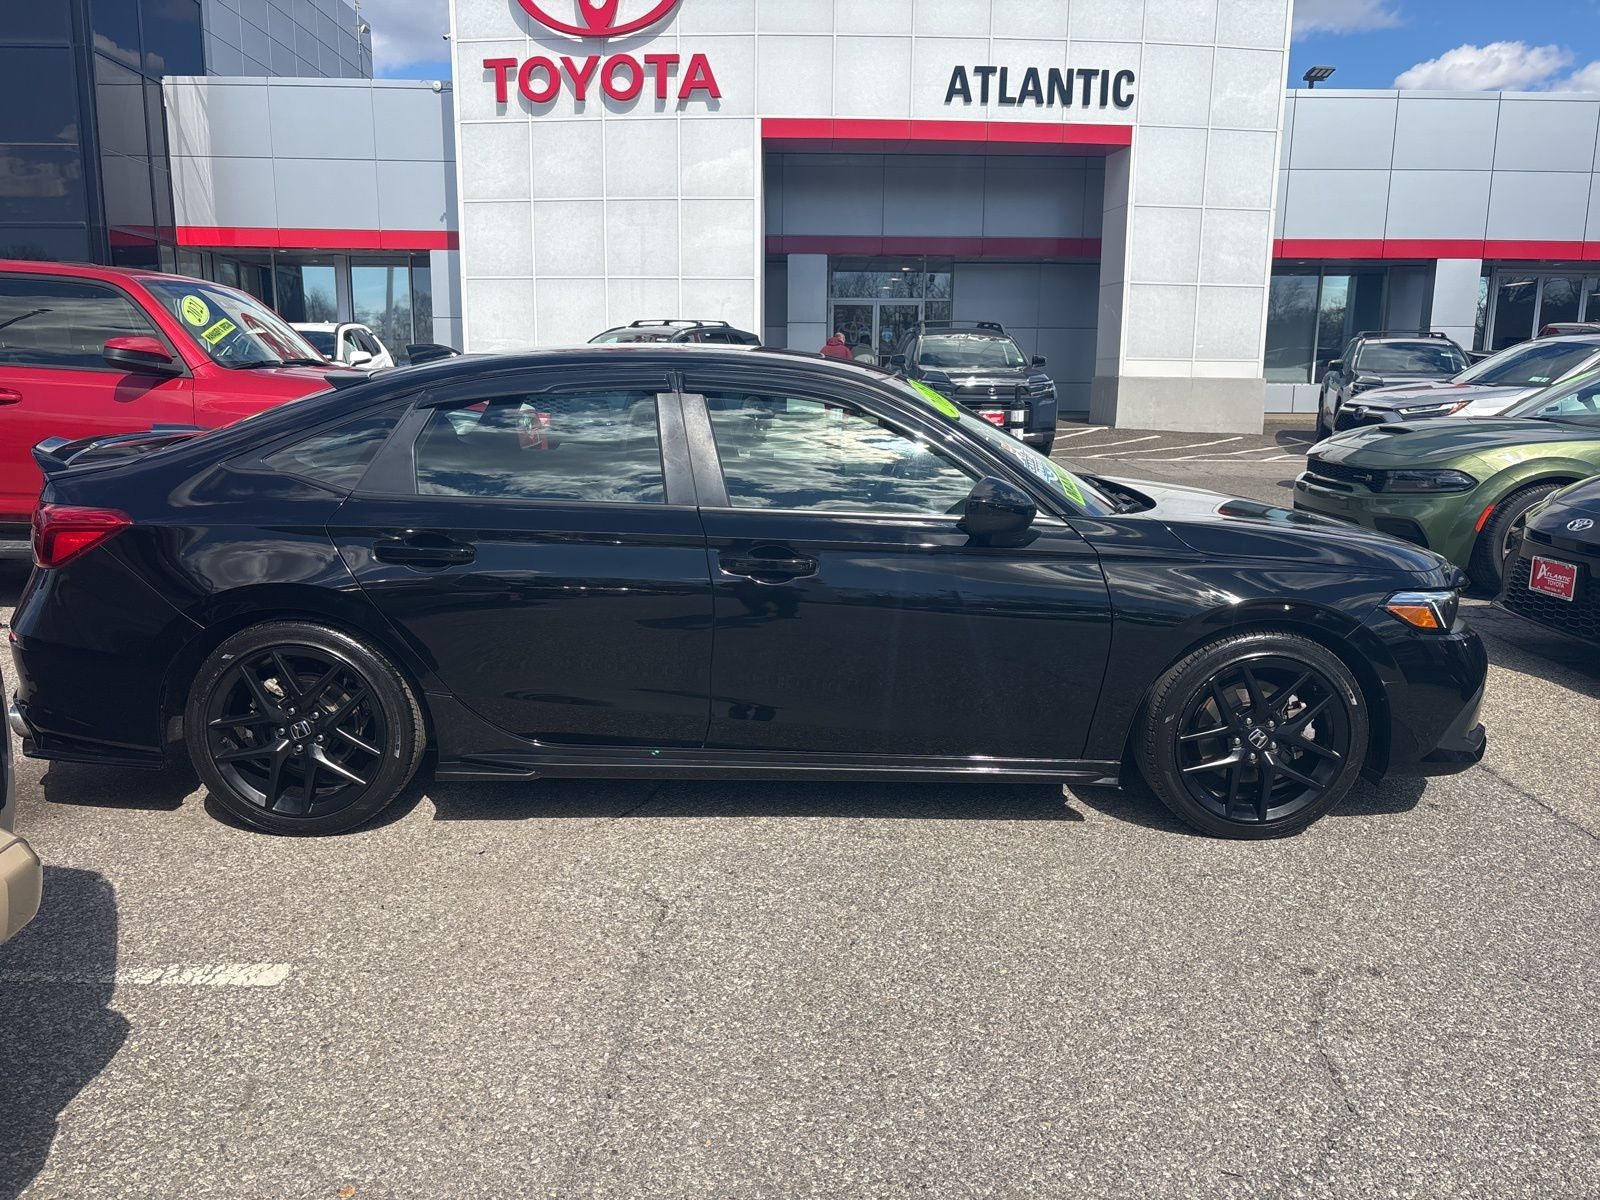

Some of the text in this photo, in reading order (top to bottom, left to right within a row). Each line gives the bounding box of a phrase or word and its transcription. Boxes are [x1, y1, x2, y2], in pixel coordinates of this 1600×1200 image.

[483, 53, 722, 103] TOYOTA
[944, 65, 1135, 108] ATLANTIC
[1536, 563, 1572, 582] ATLANTIC
[1547, 579, 1565, 589] TOYOTA
